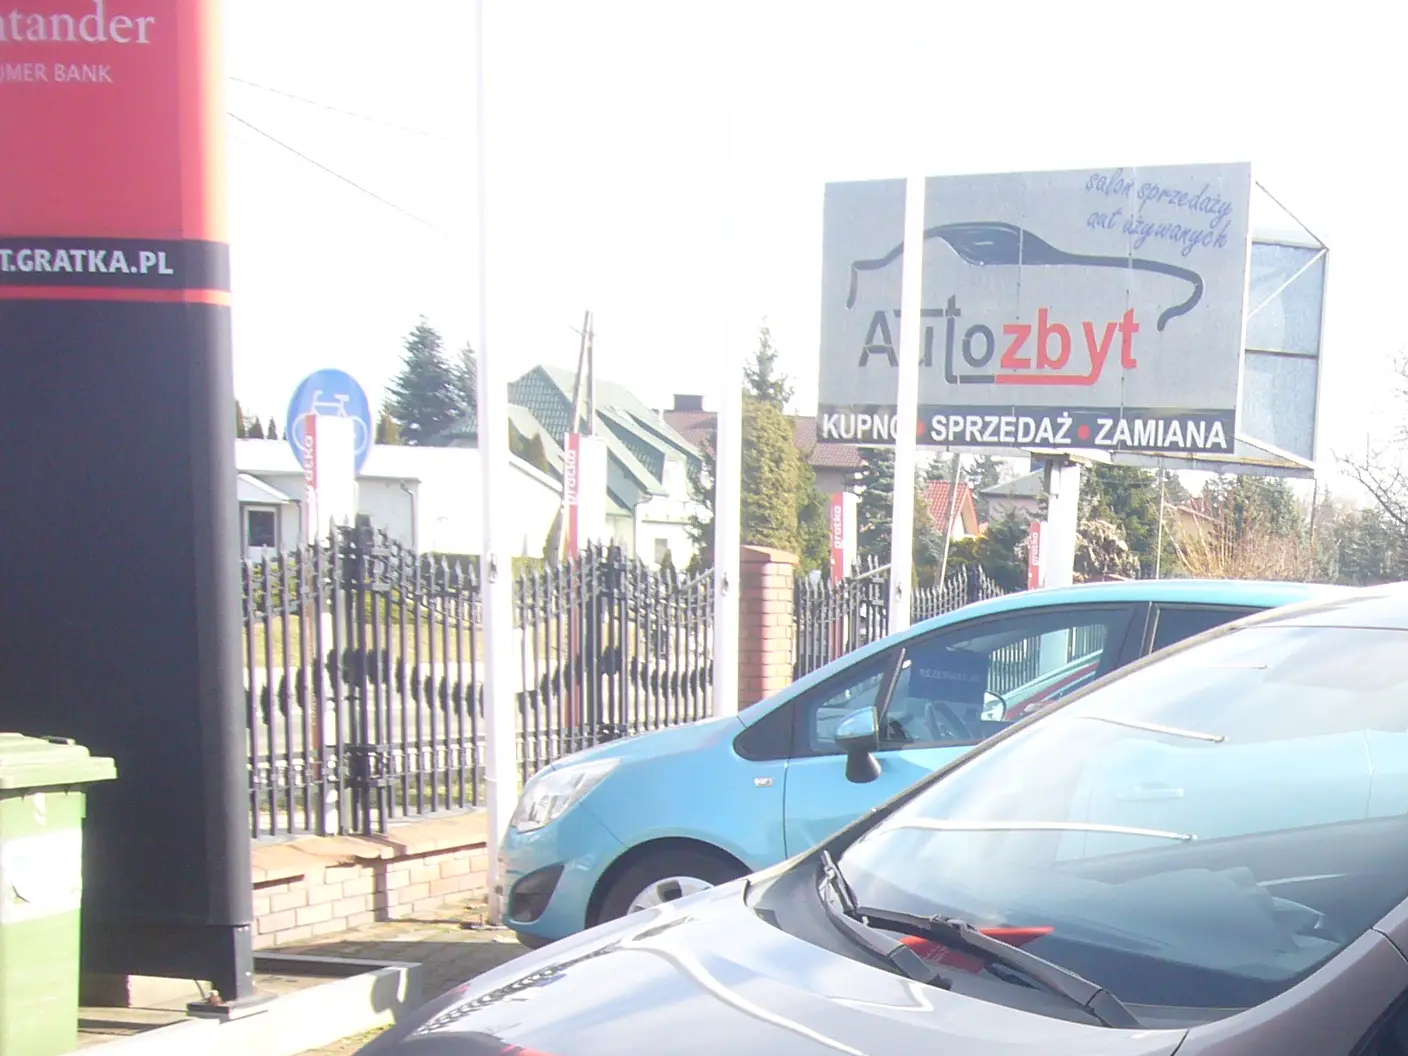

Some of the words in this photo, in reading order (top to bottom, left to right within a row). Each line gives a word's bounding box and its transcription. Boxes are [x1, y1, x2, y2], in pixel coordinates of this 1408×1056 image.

[0, 0, 155, 43] tander
[0, 63, 48, 82] MER
[54, 64, 114, 83] BANK
[1085, 168, 1134, 198] salon
[1137, 183, 1233, 229] sprzedaży
[931, 411, 1073, 445] SPRZEDAŻ
[1094, 417, 1228, 450] ZAMIANA
